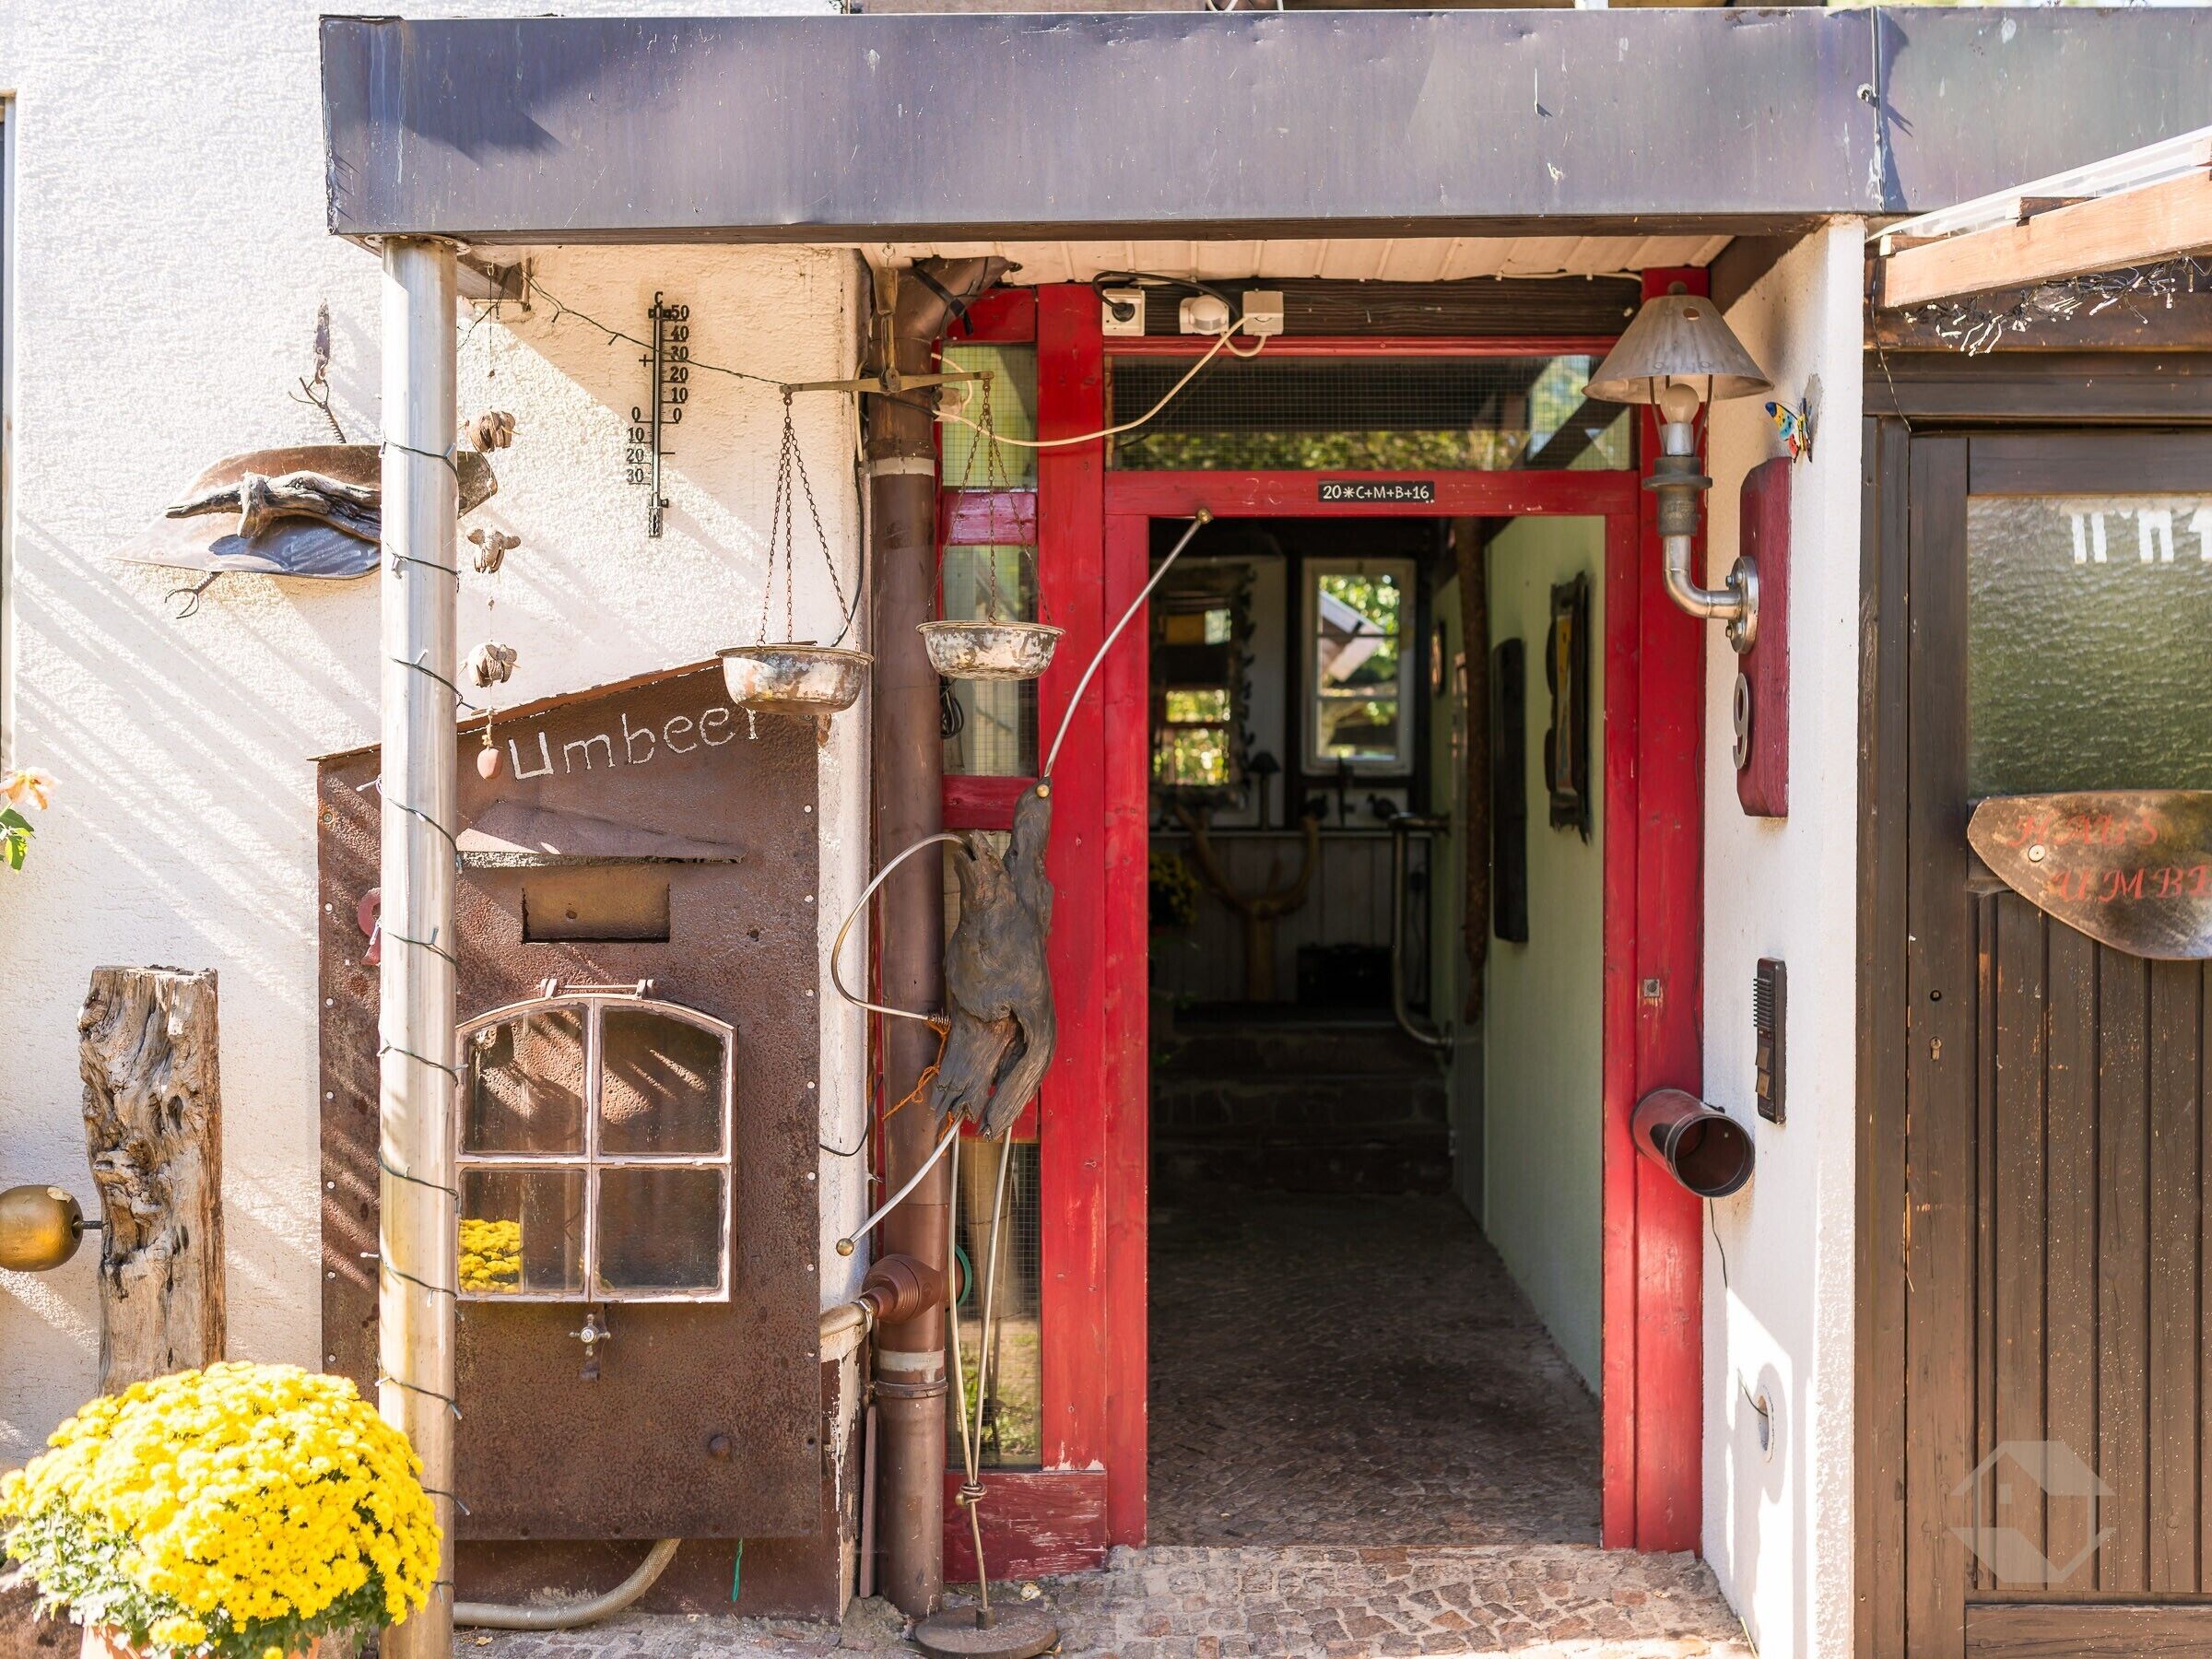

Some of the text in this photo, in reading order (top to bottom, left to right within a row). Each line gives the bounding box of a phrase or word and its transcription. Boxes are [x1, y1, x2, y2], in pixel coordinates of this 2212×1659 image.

[671, 304, 689, 321] 50
[671, 325, 689, 341] 40
[670, 346, 689, 360] 30
[670, 366, 688, 382] 20
[671, 387, 688, 403] 10
[631, 406, 641, 422] 0
[673, 407, 682, 423] 0
[627, 427, 645, 442] 10
[627, 448, 644, 463] 20
[627, 468, 644, 483] 30
[1733, 672, 1748, 770] 9
[2006, 809, 2161, 848] HAUS
